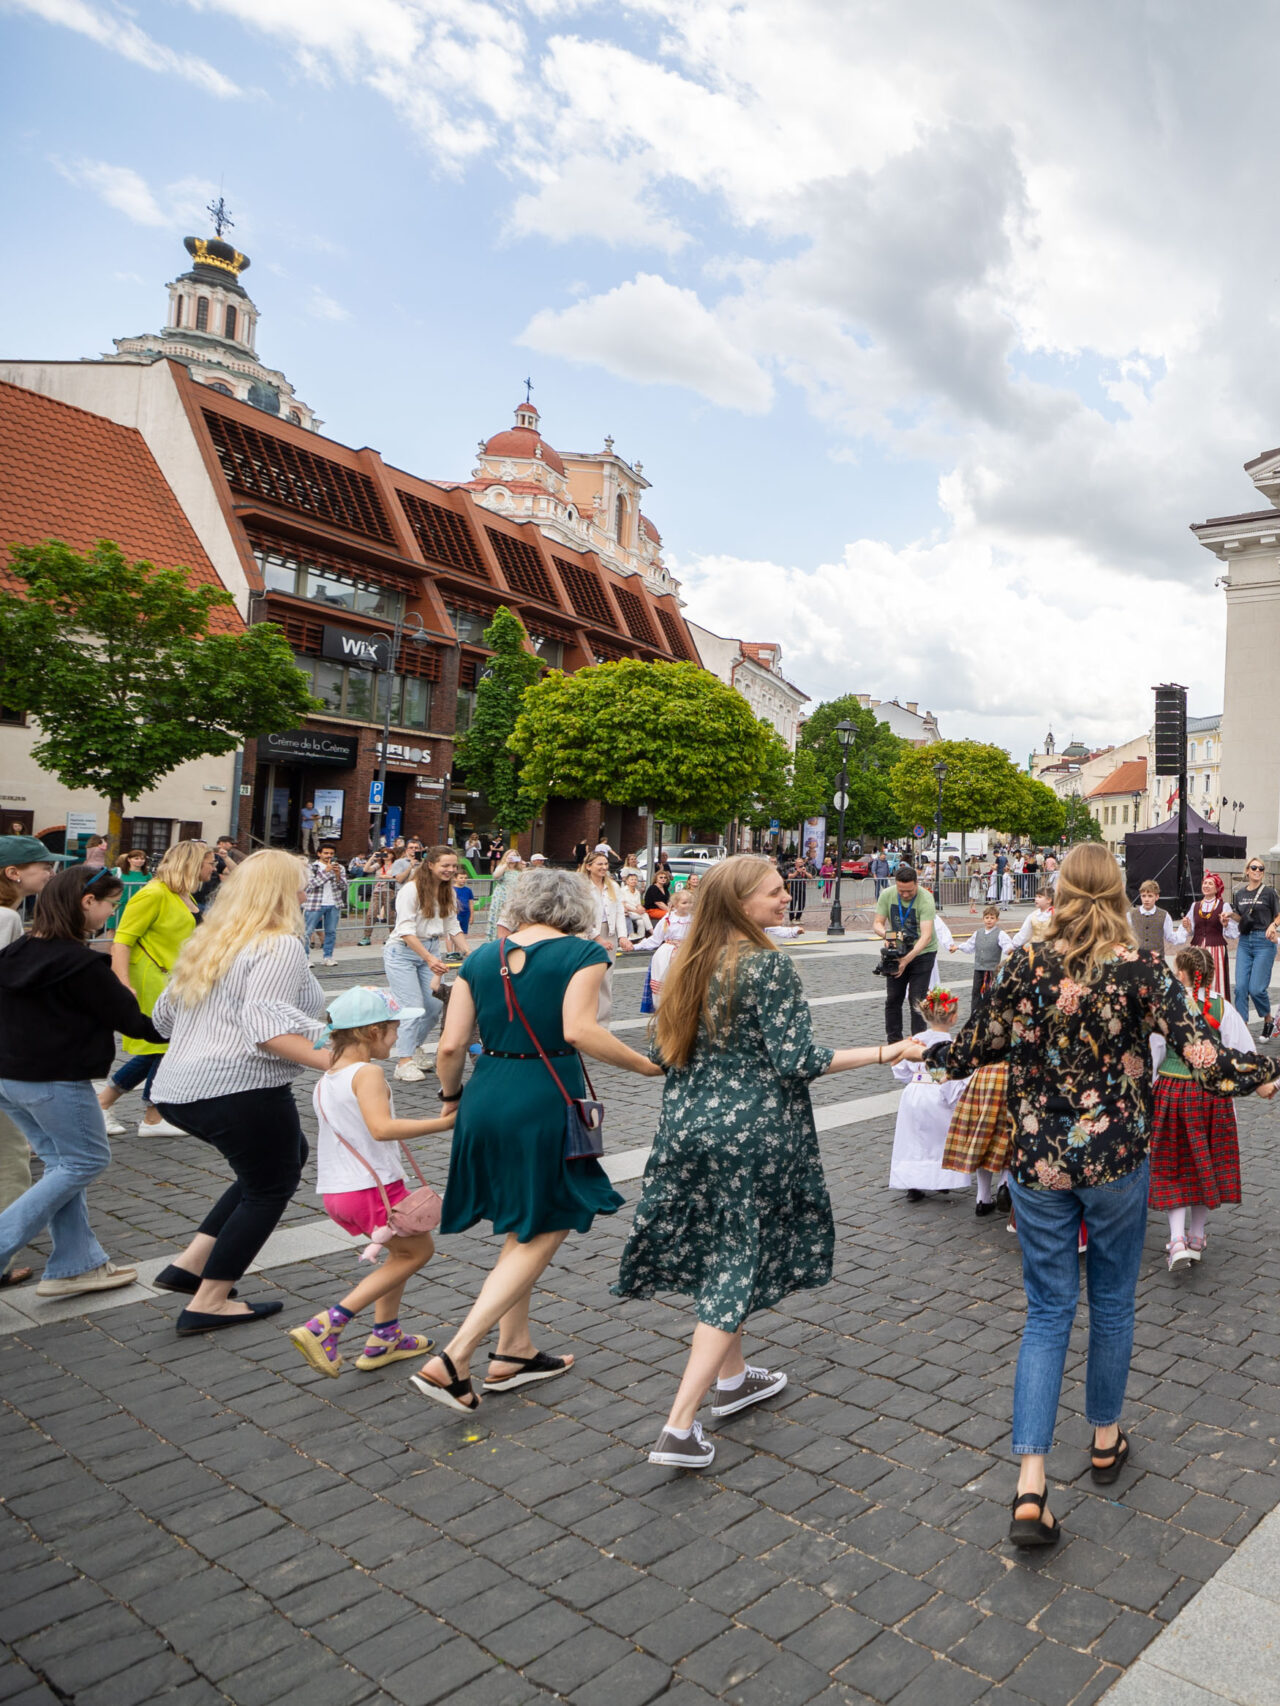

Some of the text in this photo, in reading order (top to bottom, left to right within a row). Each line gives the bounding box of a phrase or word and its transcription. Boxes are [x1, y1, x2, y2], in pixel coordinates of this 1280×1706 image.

[268, 733, 299, 748] Crème
[300, 738, 311, 749] de
[312, 738, 321, 750] la
[321, 740, 350, 754] Crème
[373, 783, 382, 795] P
